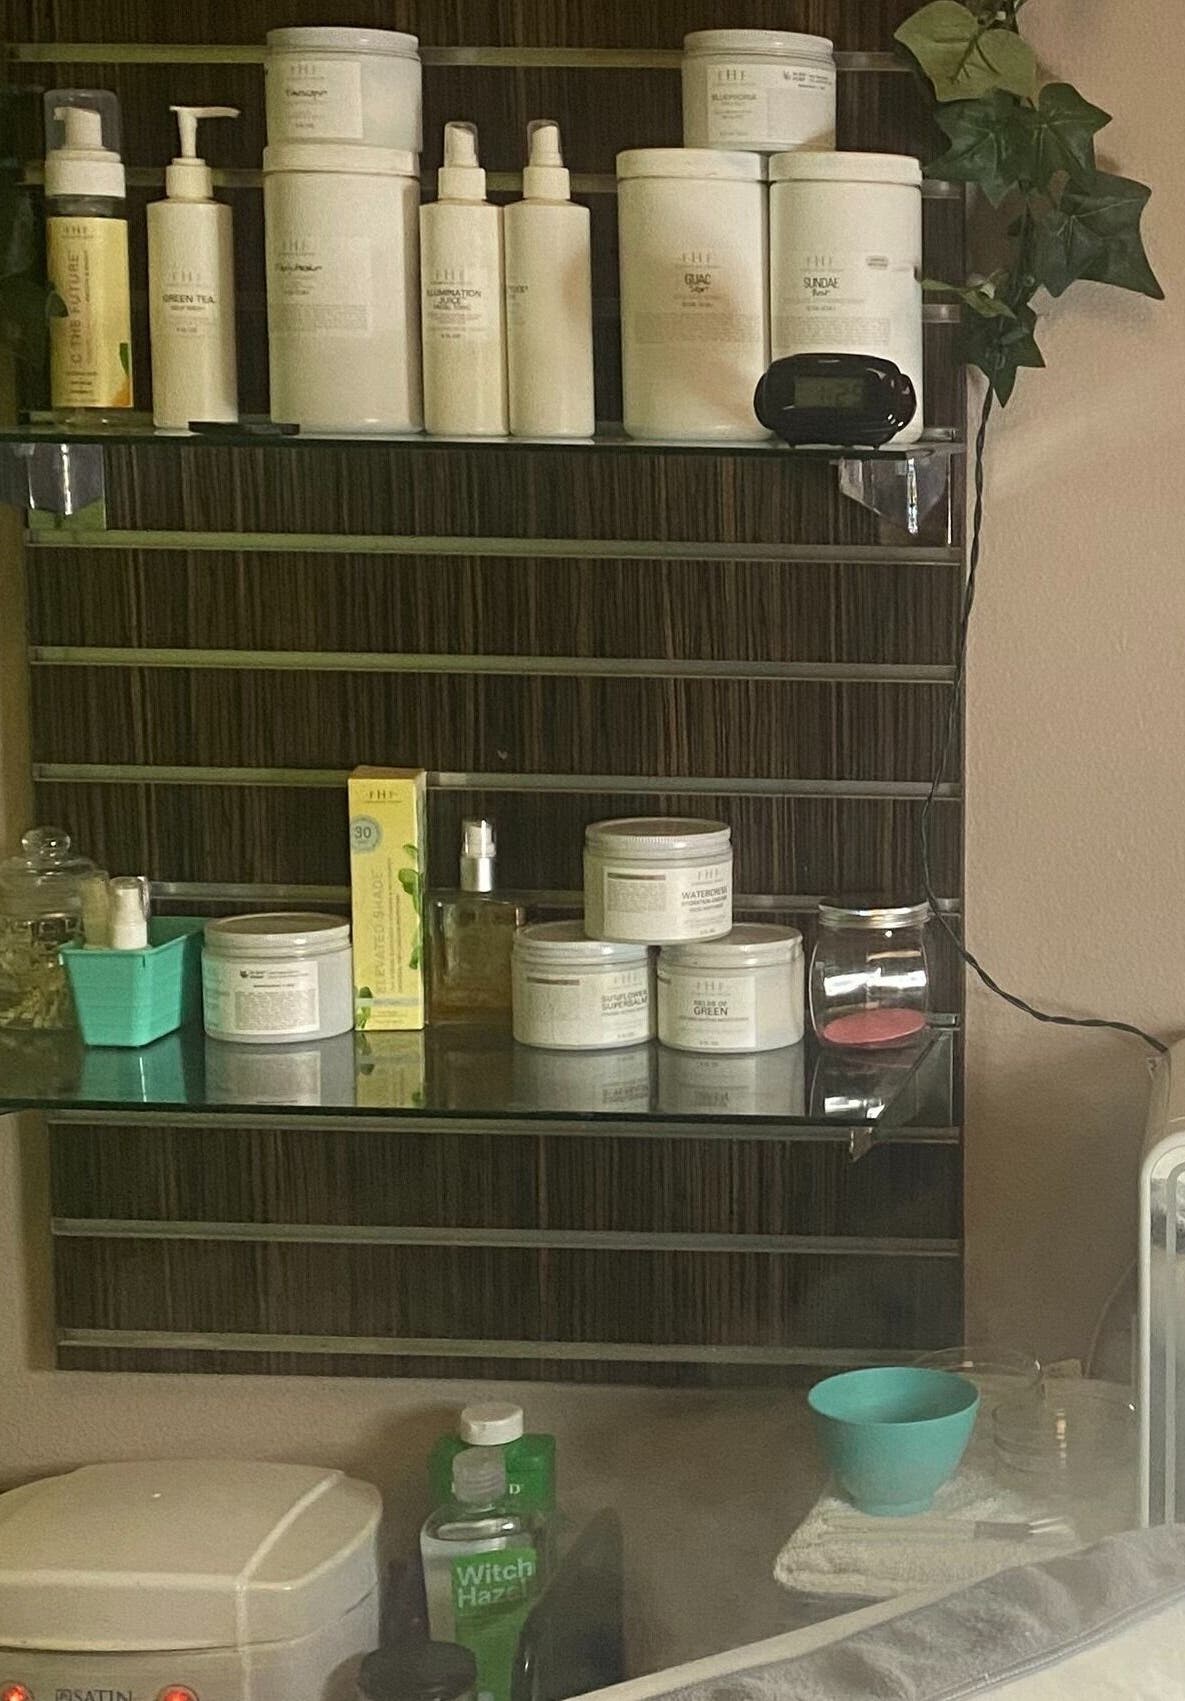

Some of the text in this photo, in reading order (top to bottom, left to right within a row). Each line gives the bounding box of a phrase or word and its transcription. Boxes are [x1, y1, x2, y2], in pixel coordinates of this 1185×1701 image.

[684, 273, 712, 285] GUAC
[803, 277, 840, 289] SUNDAE
[162, 294, 216, 304] GREEN TEA
[354, 826, 372, 839] 30
[371, 870, 384, 918] SHADE
[693, 1006, 729, 1016] GREEN
[456, 1558, 534, 1587] Witch
